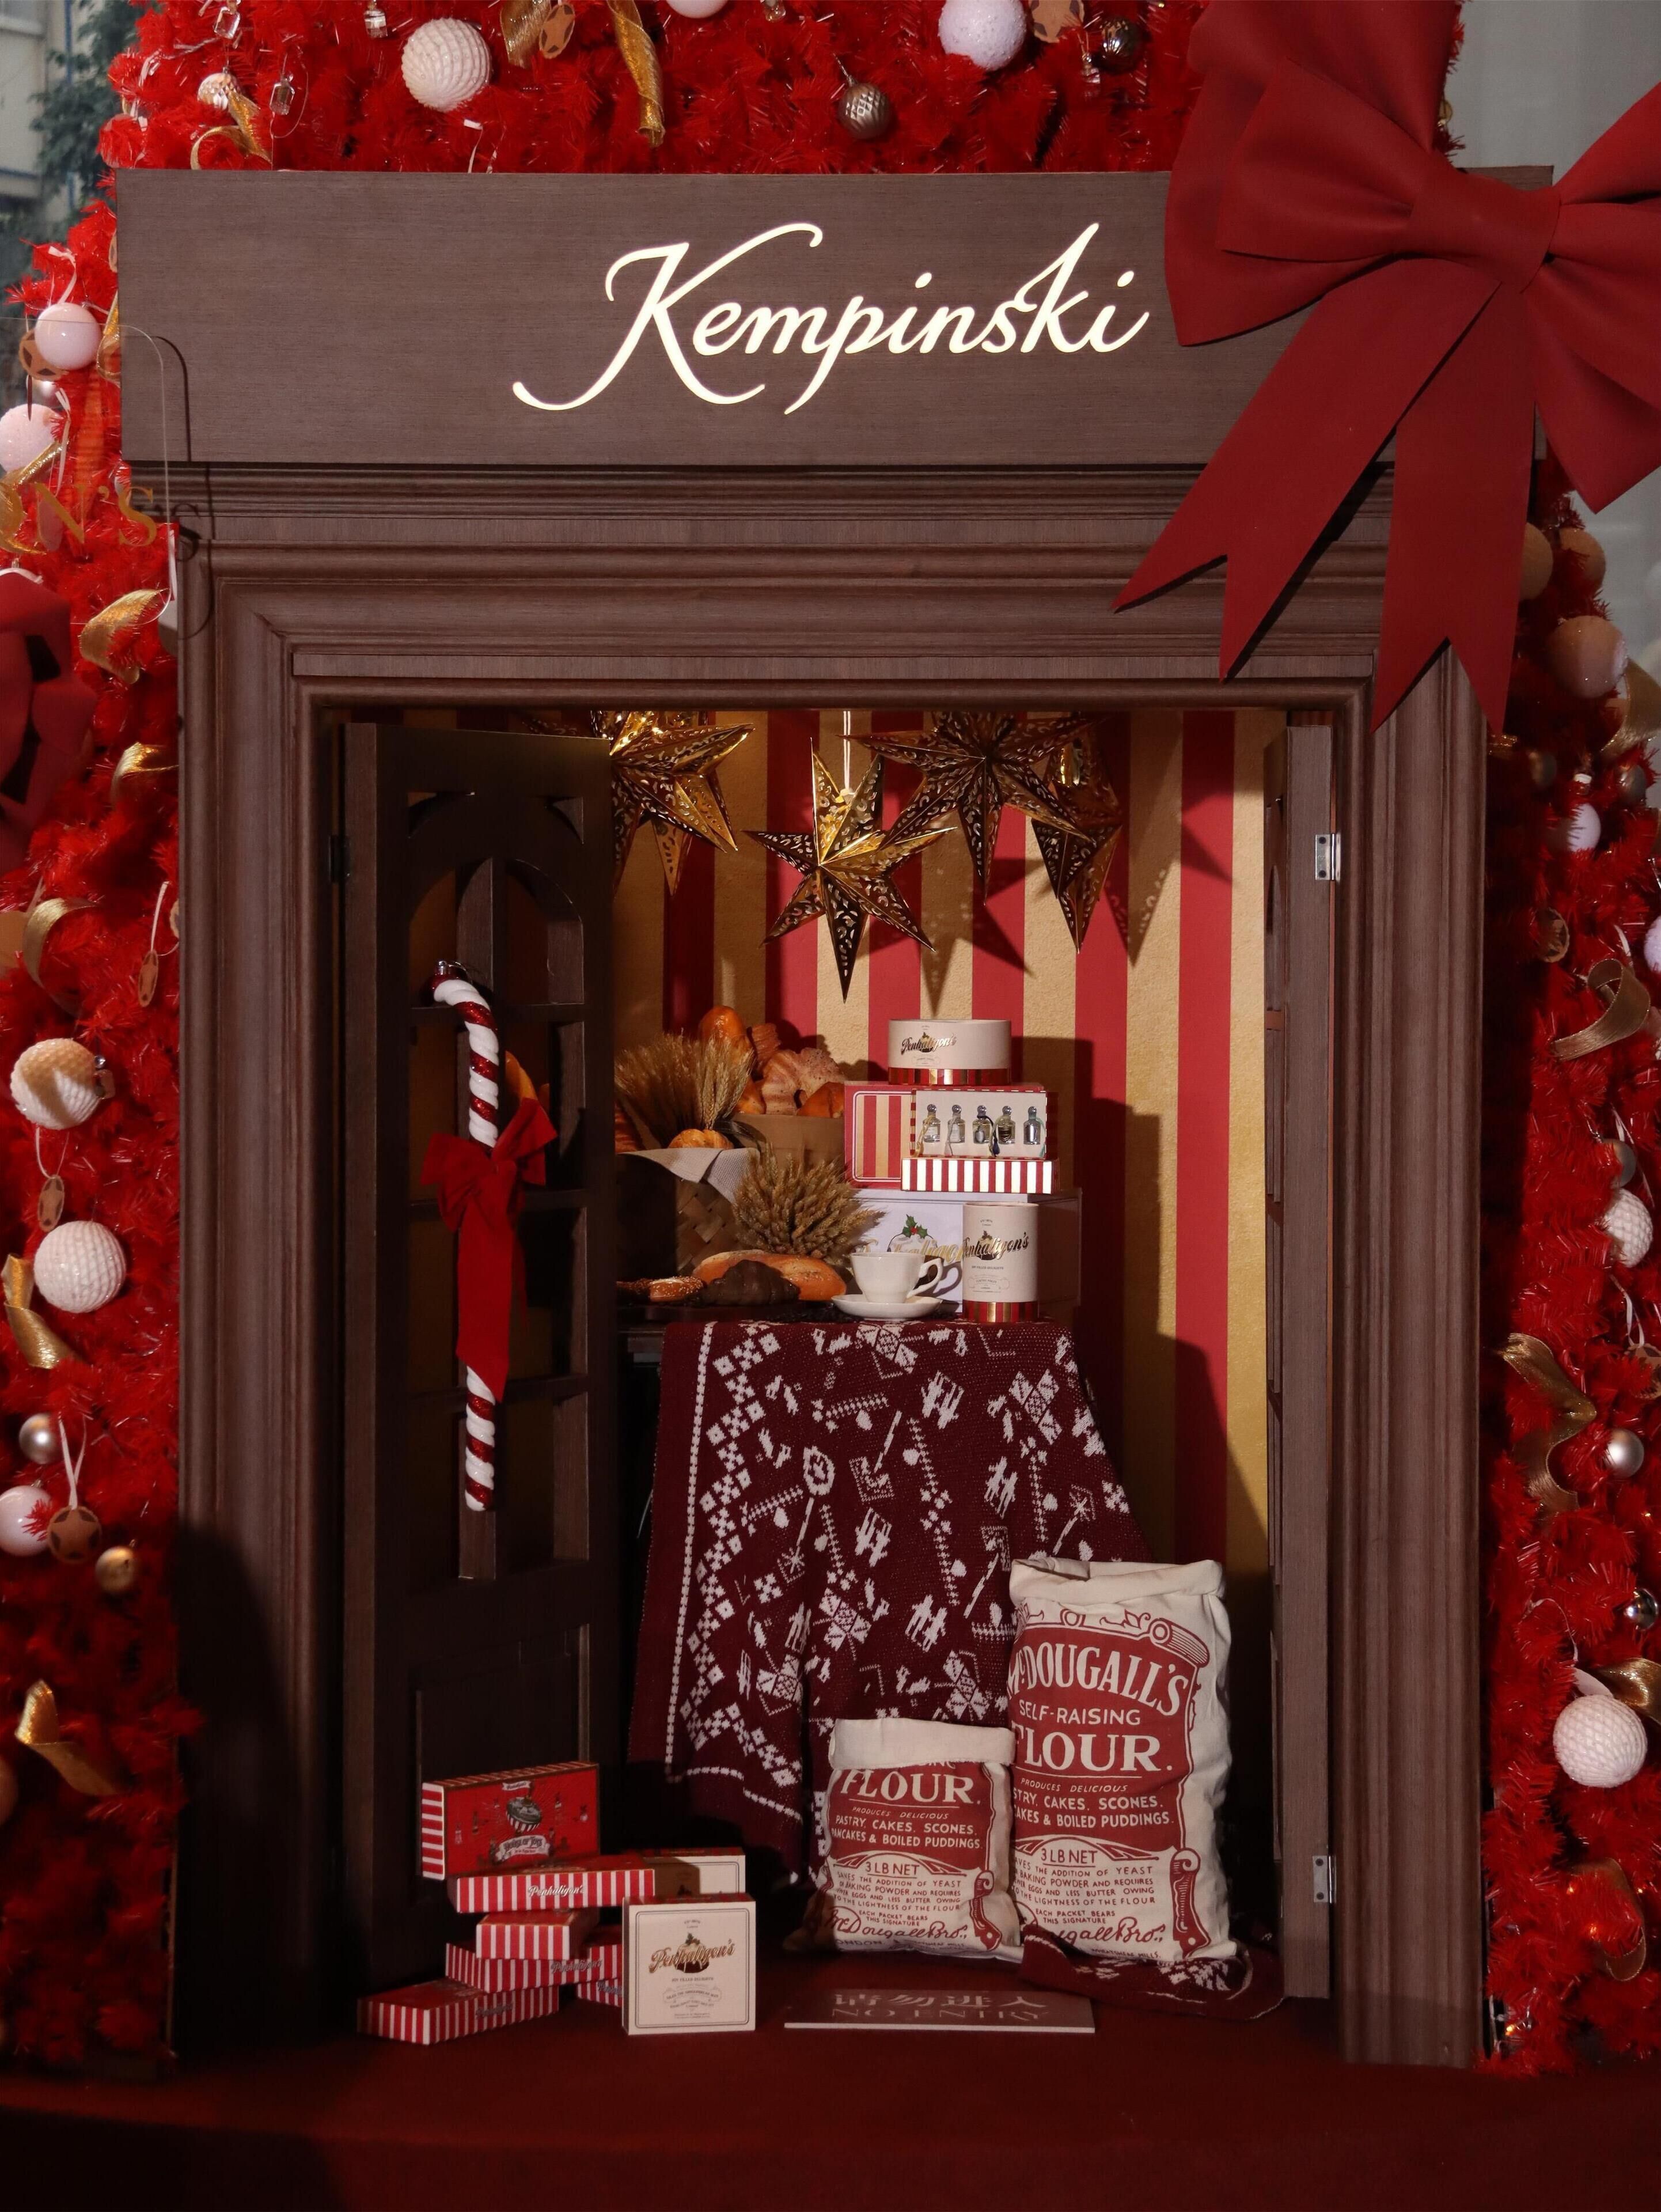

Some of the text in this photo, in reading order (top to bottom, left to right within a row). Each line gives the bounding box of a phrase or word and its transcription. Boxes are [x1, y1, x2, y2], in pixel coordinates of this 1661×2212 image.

[512, 222, 1149, 414] Kempinski
[1019, 1699, 1141, 1726] SELF-RAISING
[1021, 1778, 1128, 1793] PRODUCES DELICIOUS
[852, 1806, 950, 1820] PRODUCES DELICIOUS
[1043, 1815, 1051, 1825] &
[1057, 1814, 1097, 1828] BOILED
[869, 1834, 877, 1843] &
[883, 1834, 920, 1847] BOILED
[1041, 1849, 1098, 1864] 3 LB NET
[866, 1862, 920, 1876] 3 LB NET
[1014, 1857, 1031, 1870] AVES
[1036, 1866, 1048, 1874] THE
[1116, 1866, 1153, 1875] YEAST
[1020, 1870, 1046, 1885] BAKING
[1051, 1878, 1089, 1888] POWDER
[528, 1885, 585, 1897] Penhaligon's
[875, 1886, 910, 1895] POWDER
[1028, 1885, 1042, 1894] EGGS
[844, 1897, 855, 1906] THE
[858, 1901, 899, 1910] LIGHTNESS
[1021, 1891, 1032, 1901] THE
[1034, 1896, 1080, 1906] LIGHTNESS
[1121, 1897, 1155, 1905] FLOUR
[1036, 1908, 1052, 1916] EACH
[883, 1918, 920, 1926] SIGNATURE
[649, 1938, 735, 1974] Penhaligon's
[832, 2009, 1049, 2021] NO ENTRY
